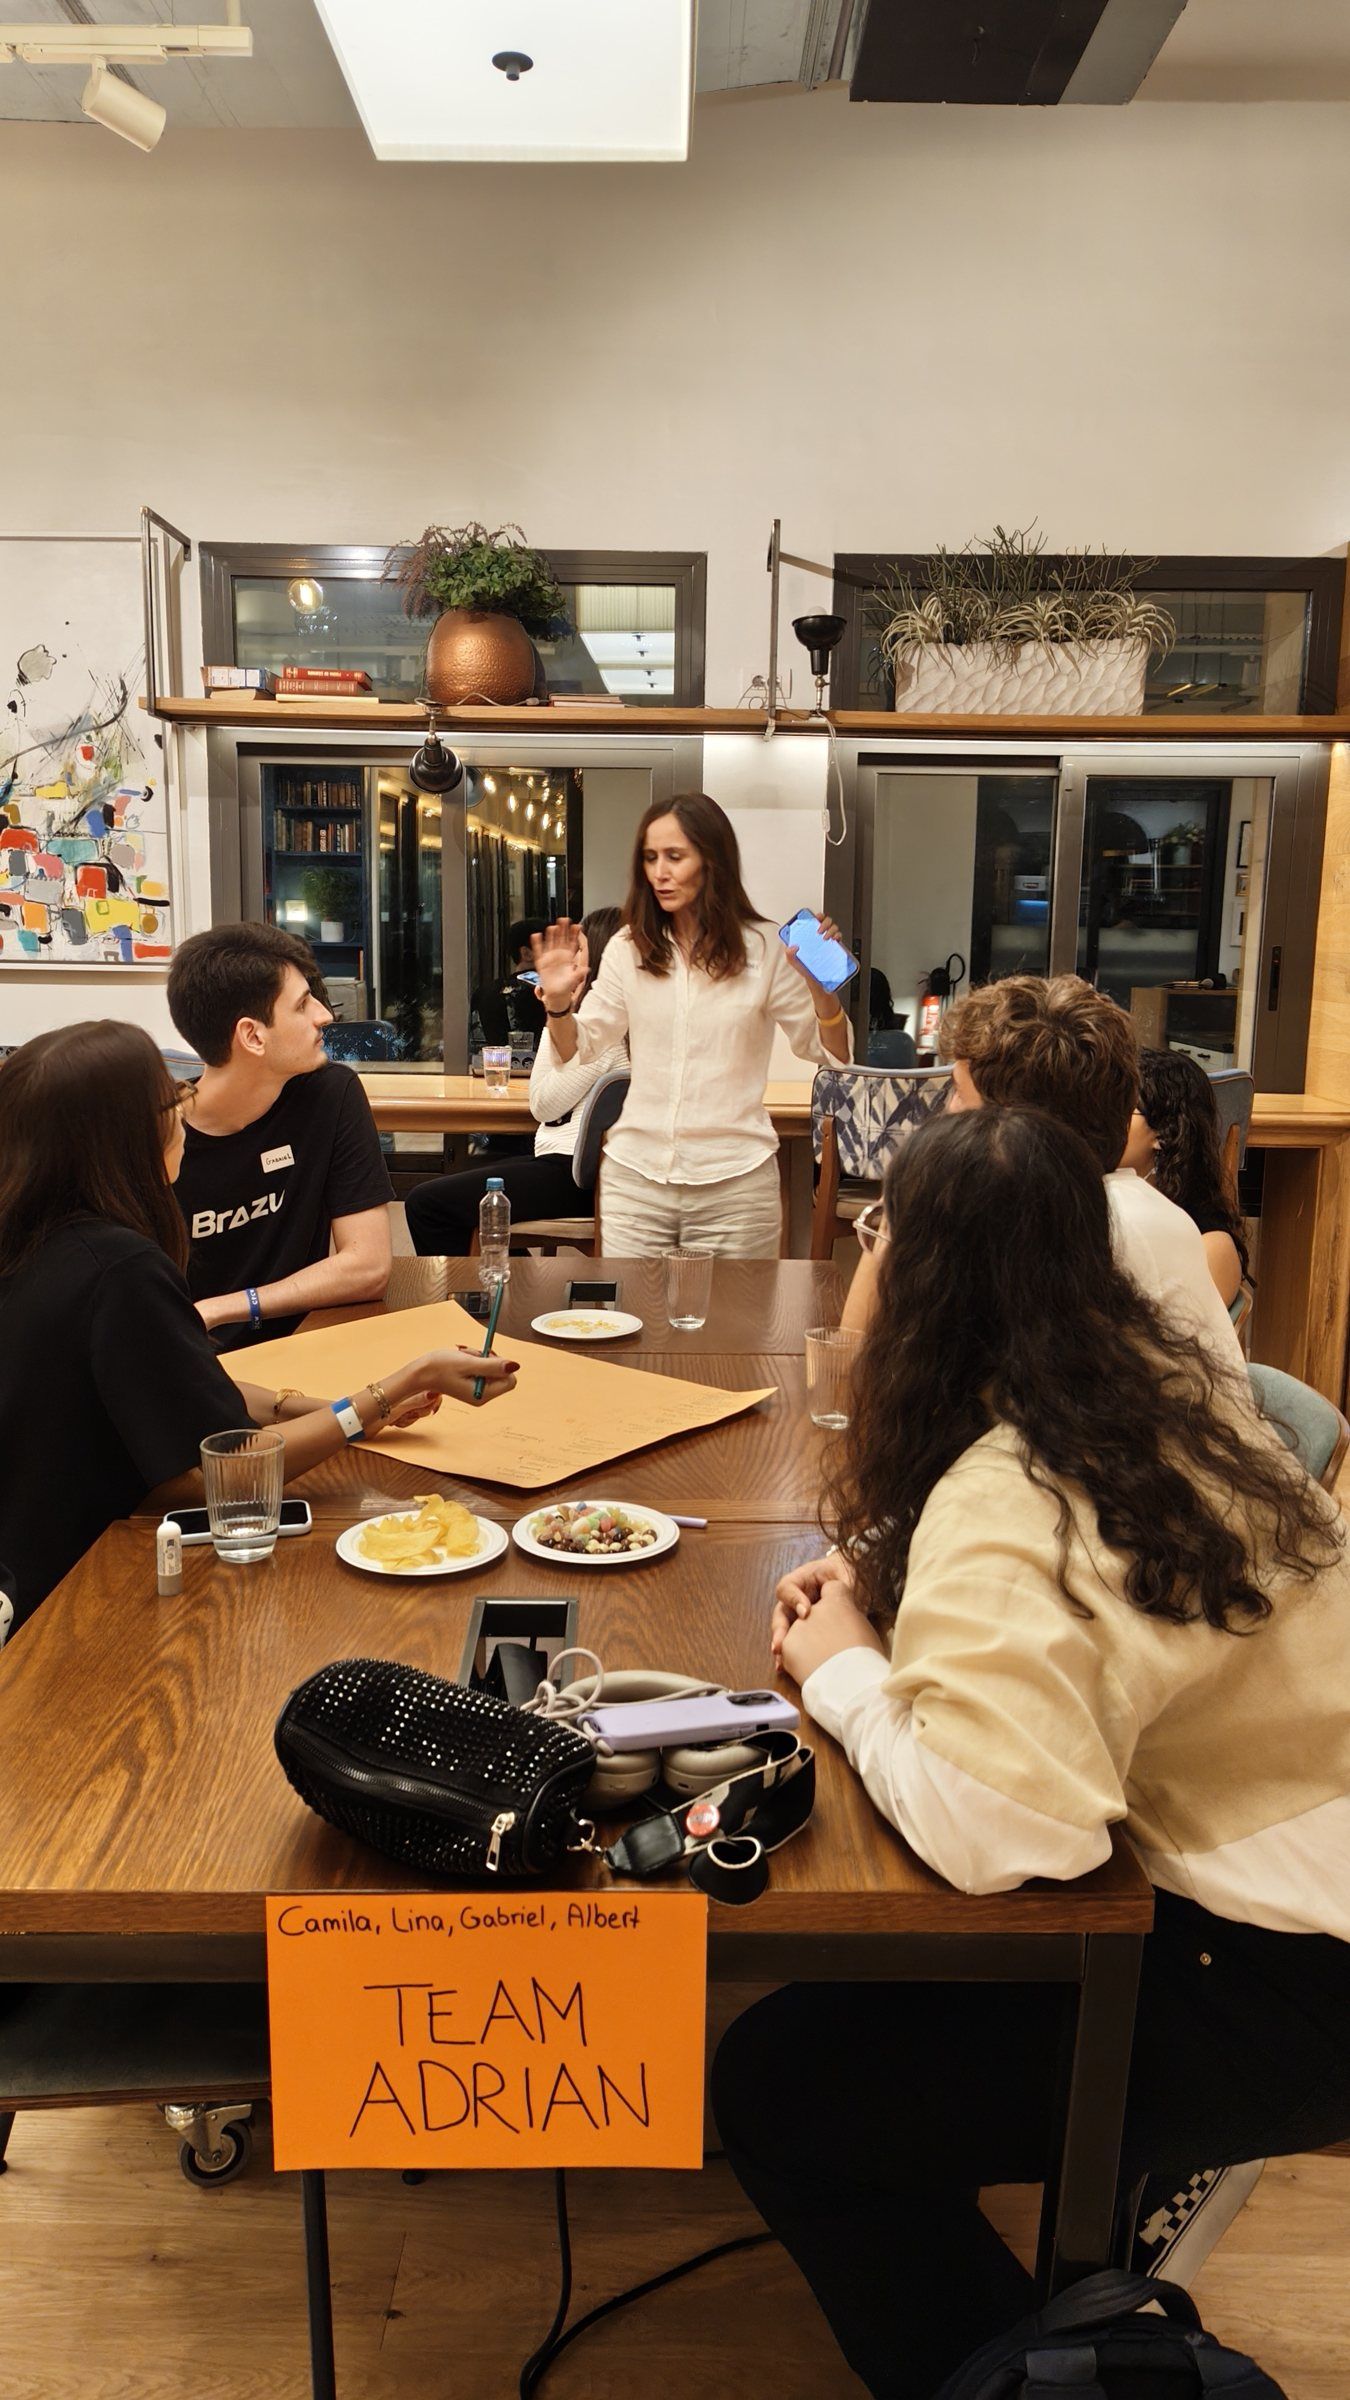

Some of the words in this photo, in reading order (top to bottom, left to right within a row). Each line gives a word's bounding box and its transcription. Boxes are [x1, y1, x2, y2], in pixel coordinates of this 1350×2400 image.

[278, 1905, 380, 1937] Camila,
[391, 1906, 454, 1938] Lina,
[460, 1904, 556, 1931] Gabriel,
[567, 1902, 640, 1930] Albert
[363, 1976, 588, 2048] TEAM
[349, 2060, 650, 2138] ADRIAN
